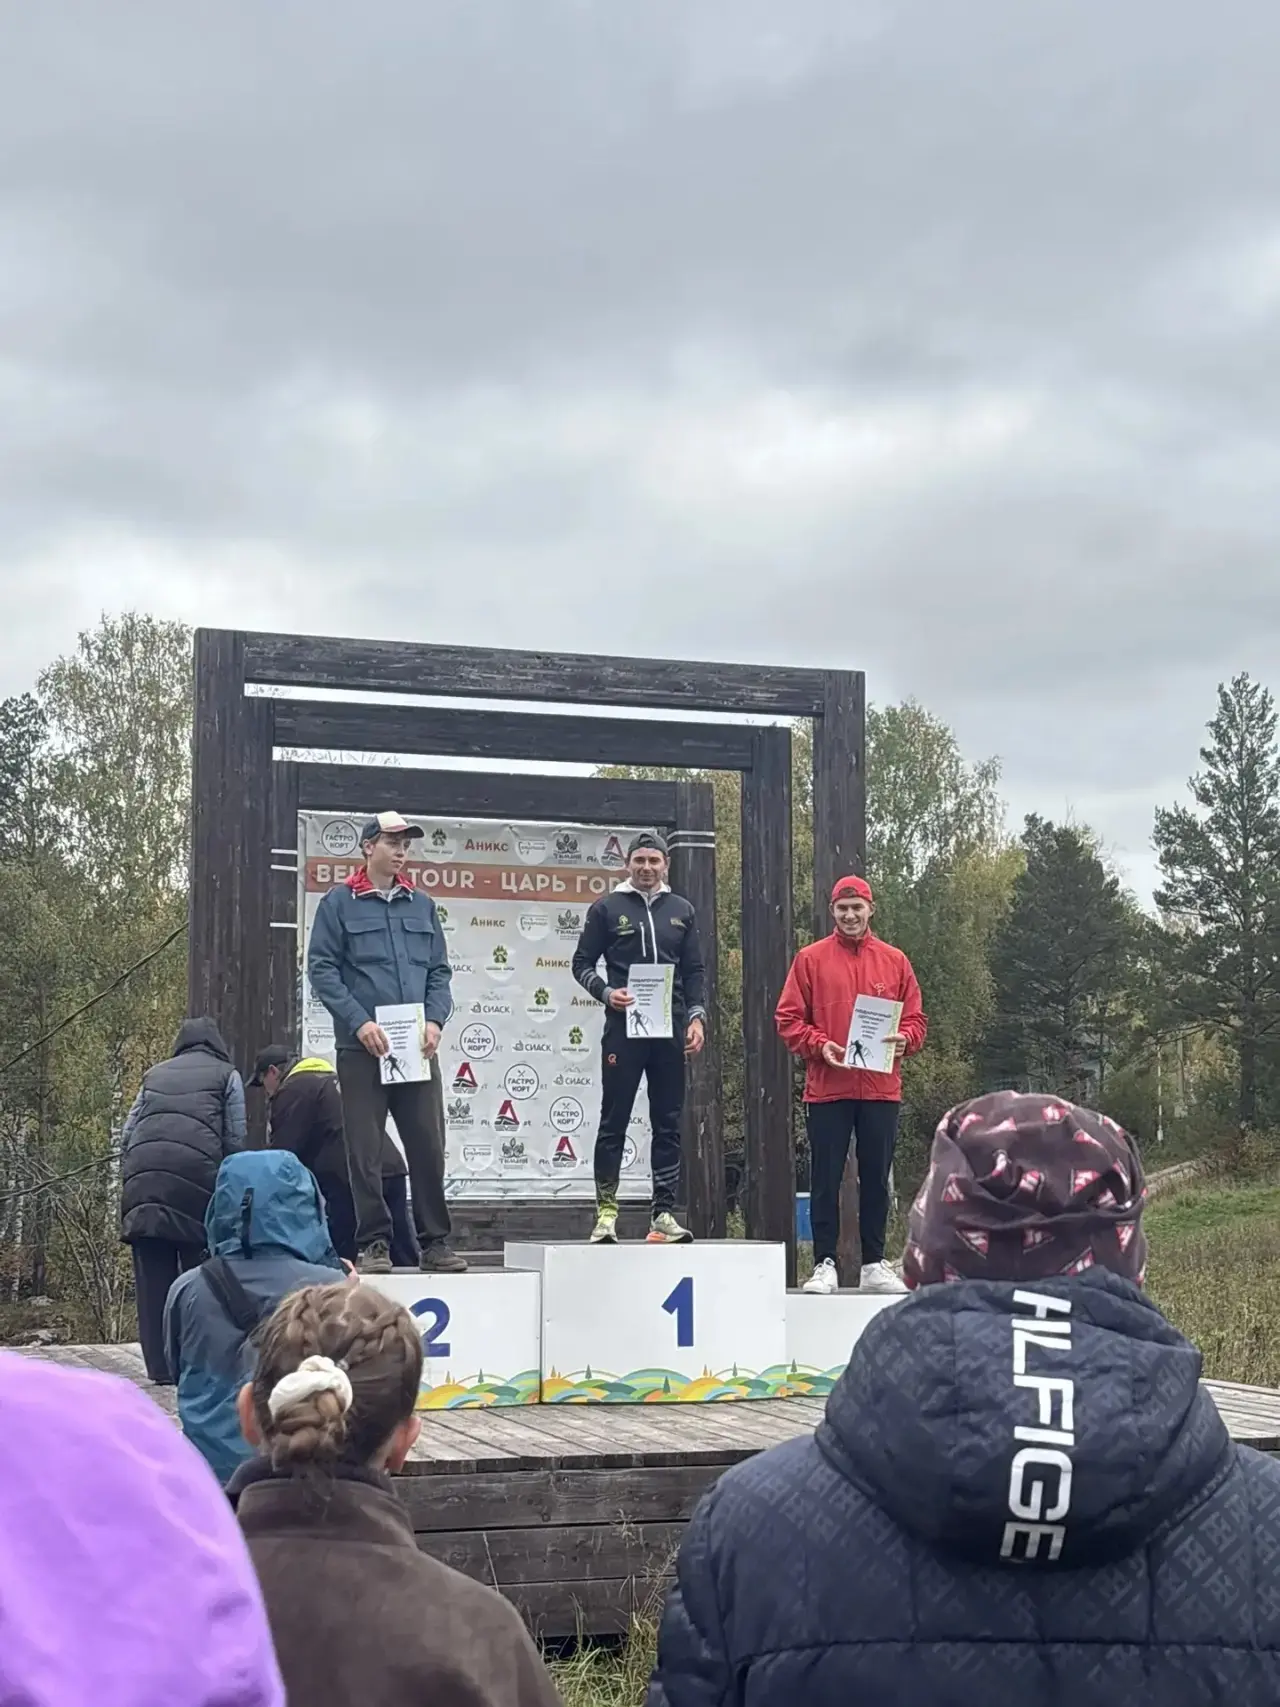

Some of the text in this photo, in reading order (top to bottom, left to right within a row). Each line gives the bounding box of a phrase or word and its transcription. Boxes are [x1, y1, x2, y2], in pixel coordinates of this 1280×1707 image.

[325, 834, 353, 842] ГАСТРО
[465, 839, 508, 852] Аникс
[407, 868, 475, 889] TOUR
[501, 872, 566, 893] ЦАРЬ
[470, 916, 506, 928] Аникс
[535, 957, 570, 968] Аникс
[482, 1005, 510, 1013] СИАСК
[525, 1043, 551, 1052] СИАСК
[508, 1077, 535, 1085] ГАСТРО
[565, 1077, 591, 1086] СИАСК
[661, 1277, 694, 1347] 1
[410, 1298, 451, 1358] 2
